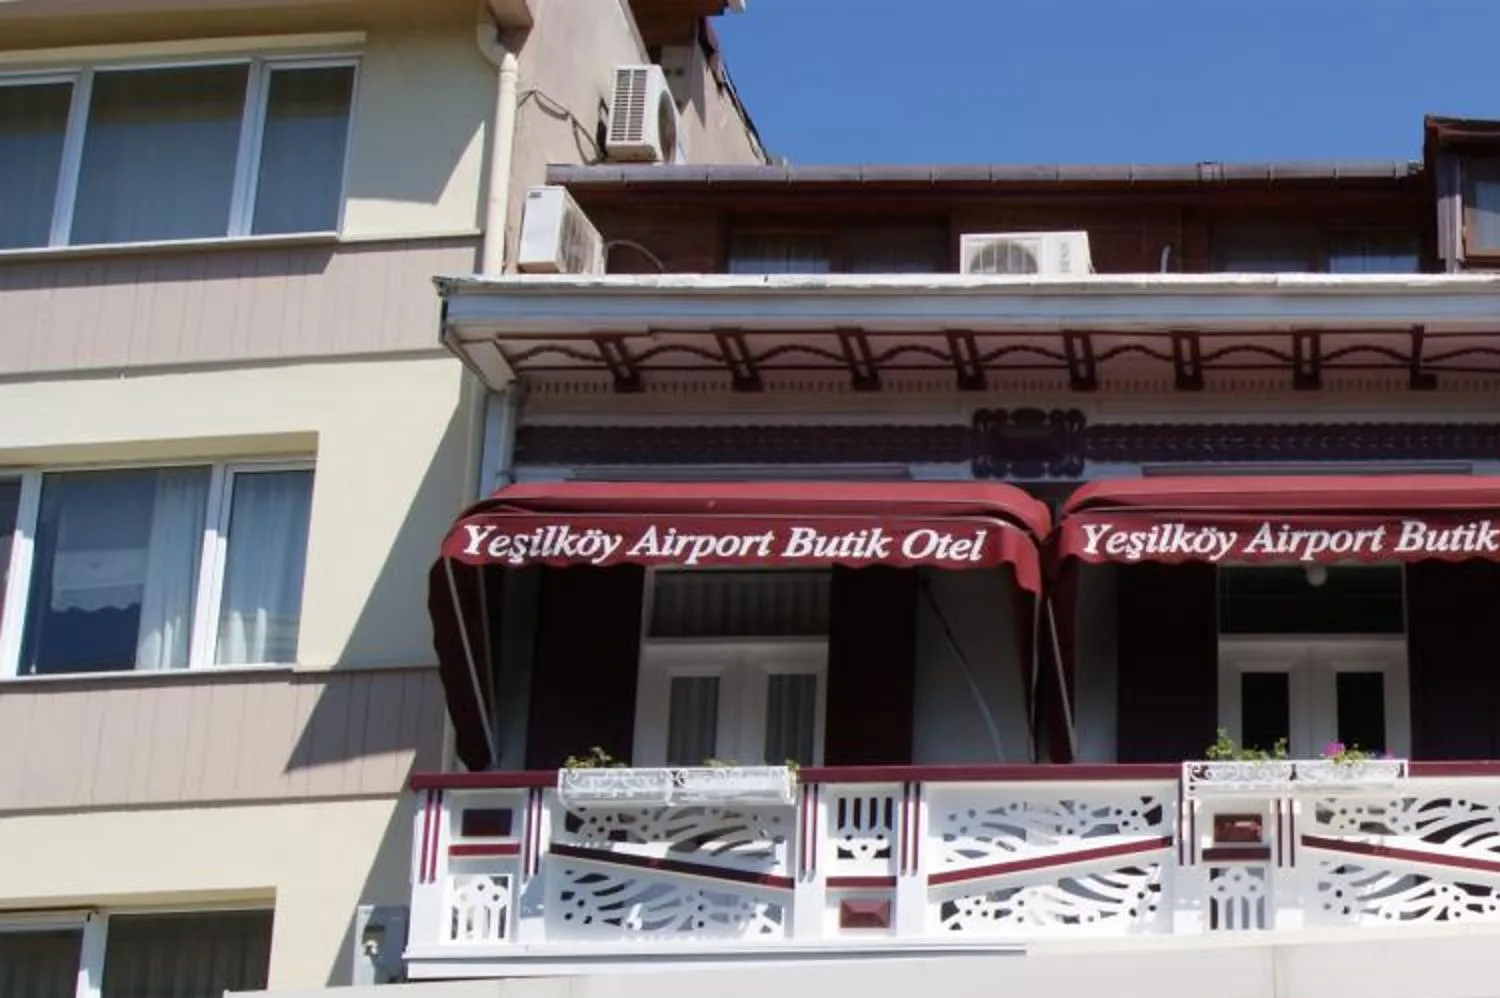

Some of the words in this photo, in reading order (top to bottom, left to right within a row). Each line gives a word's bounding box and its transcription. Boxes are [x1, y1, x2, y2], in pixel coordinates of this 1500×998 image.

[463, 525, 620, 564] Yeşilköy
[626, 526, 774, 565] Airport
[782, 527, 892, 559] Butik
[902, 529, 987, 562] Otel
[1082, 523, 1238, 560] Yeşilköy
[1244, 523, 1385, 560] Airport
[1394, 522, 1500, 552] Butik
